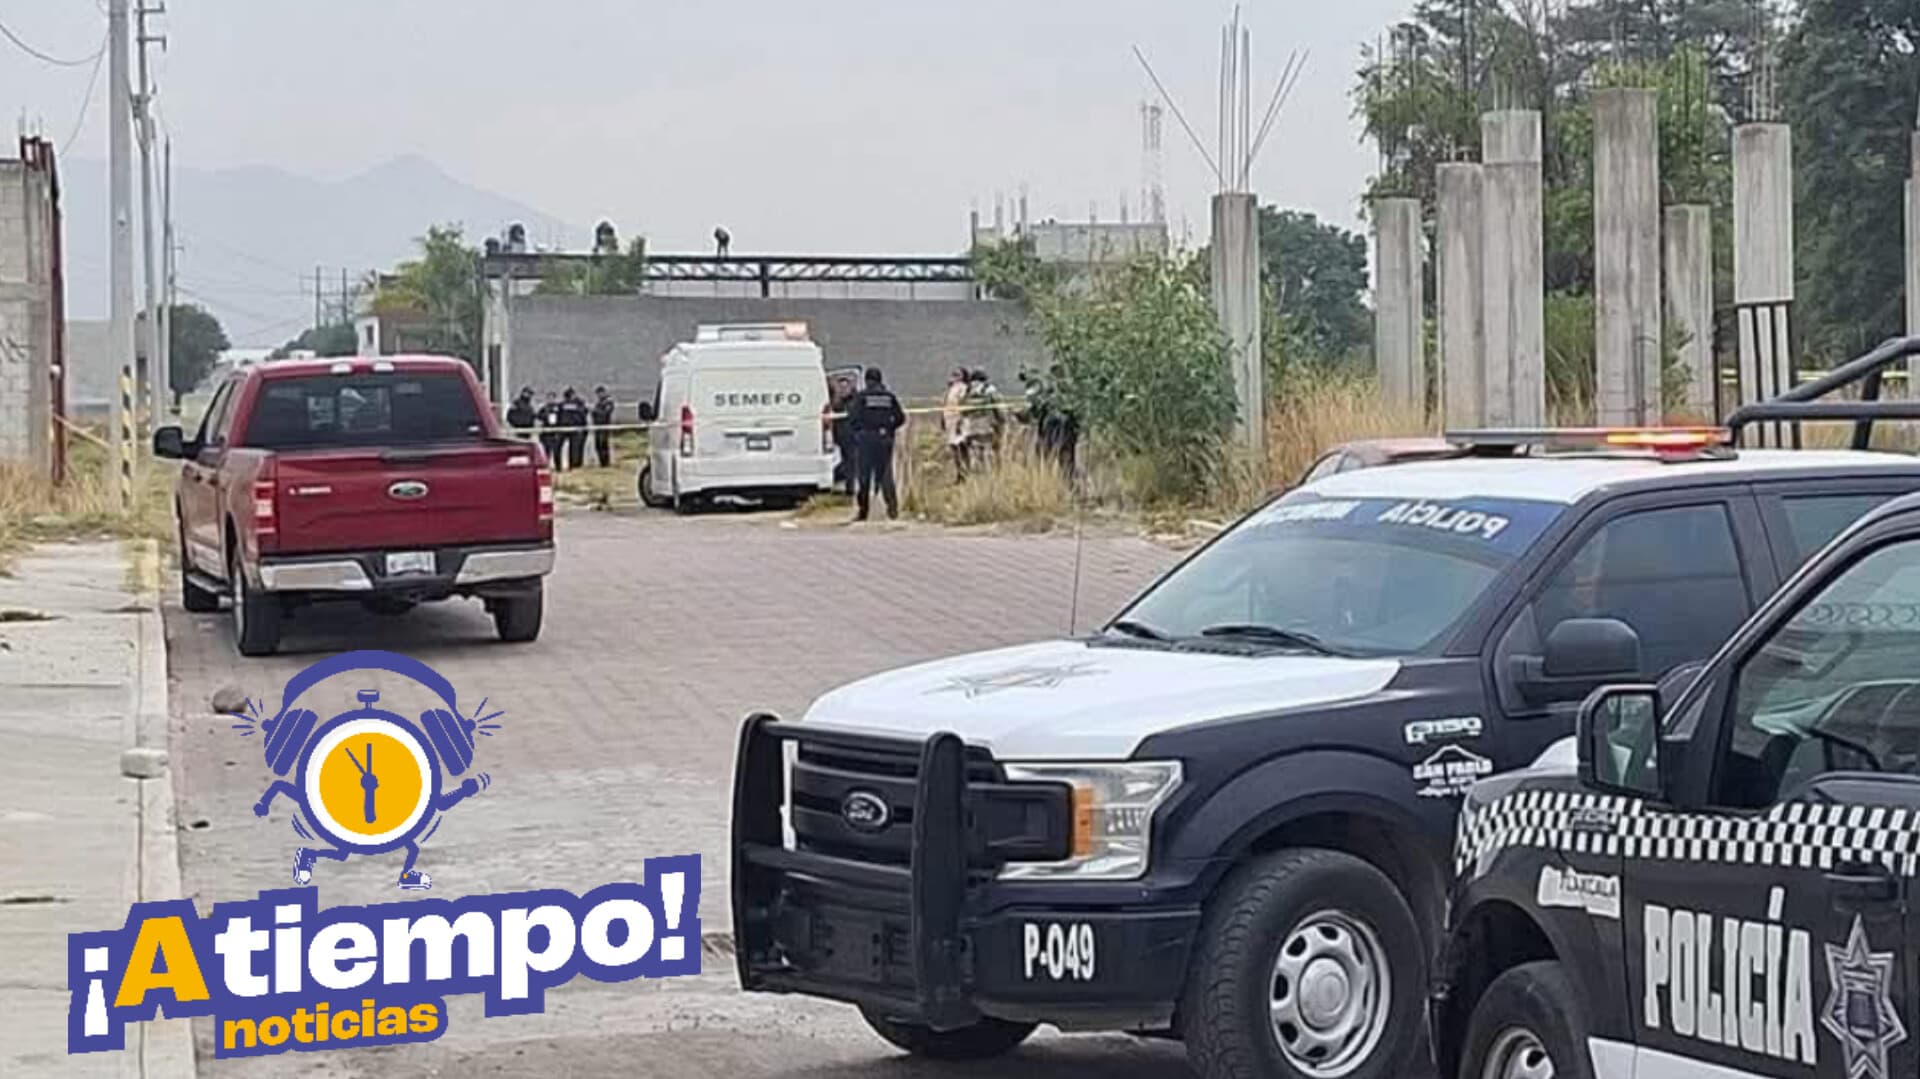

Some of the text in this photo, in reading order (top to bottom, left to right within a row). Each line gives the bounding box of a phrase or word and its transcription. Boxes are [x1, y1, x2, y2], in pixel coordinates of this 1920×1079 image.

[714, 393, 802, 407] SEMEFO
[1024, 924, 1095, 980] P-049
[1644, 886, 1817, 1065] POLICÍA
